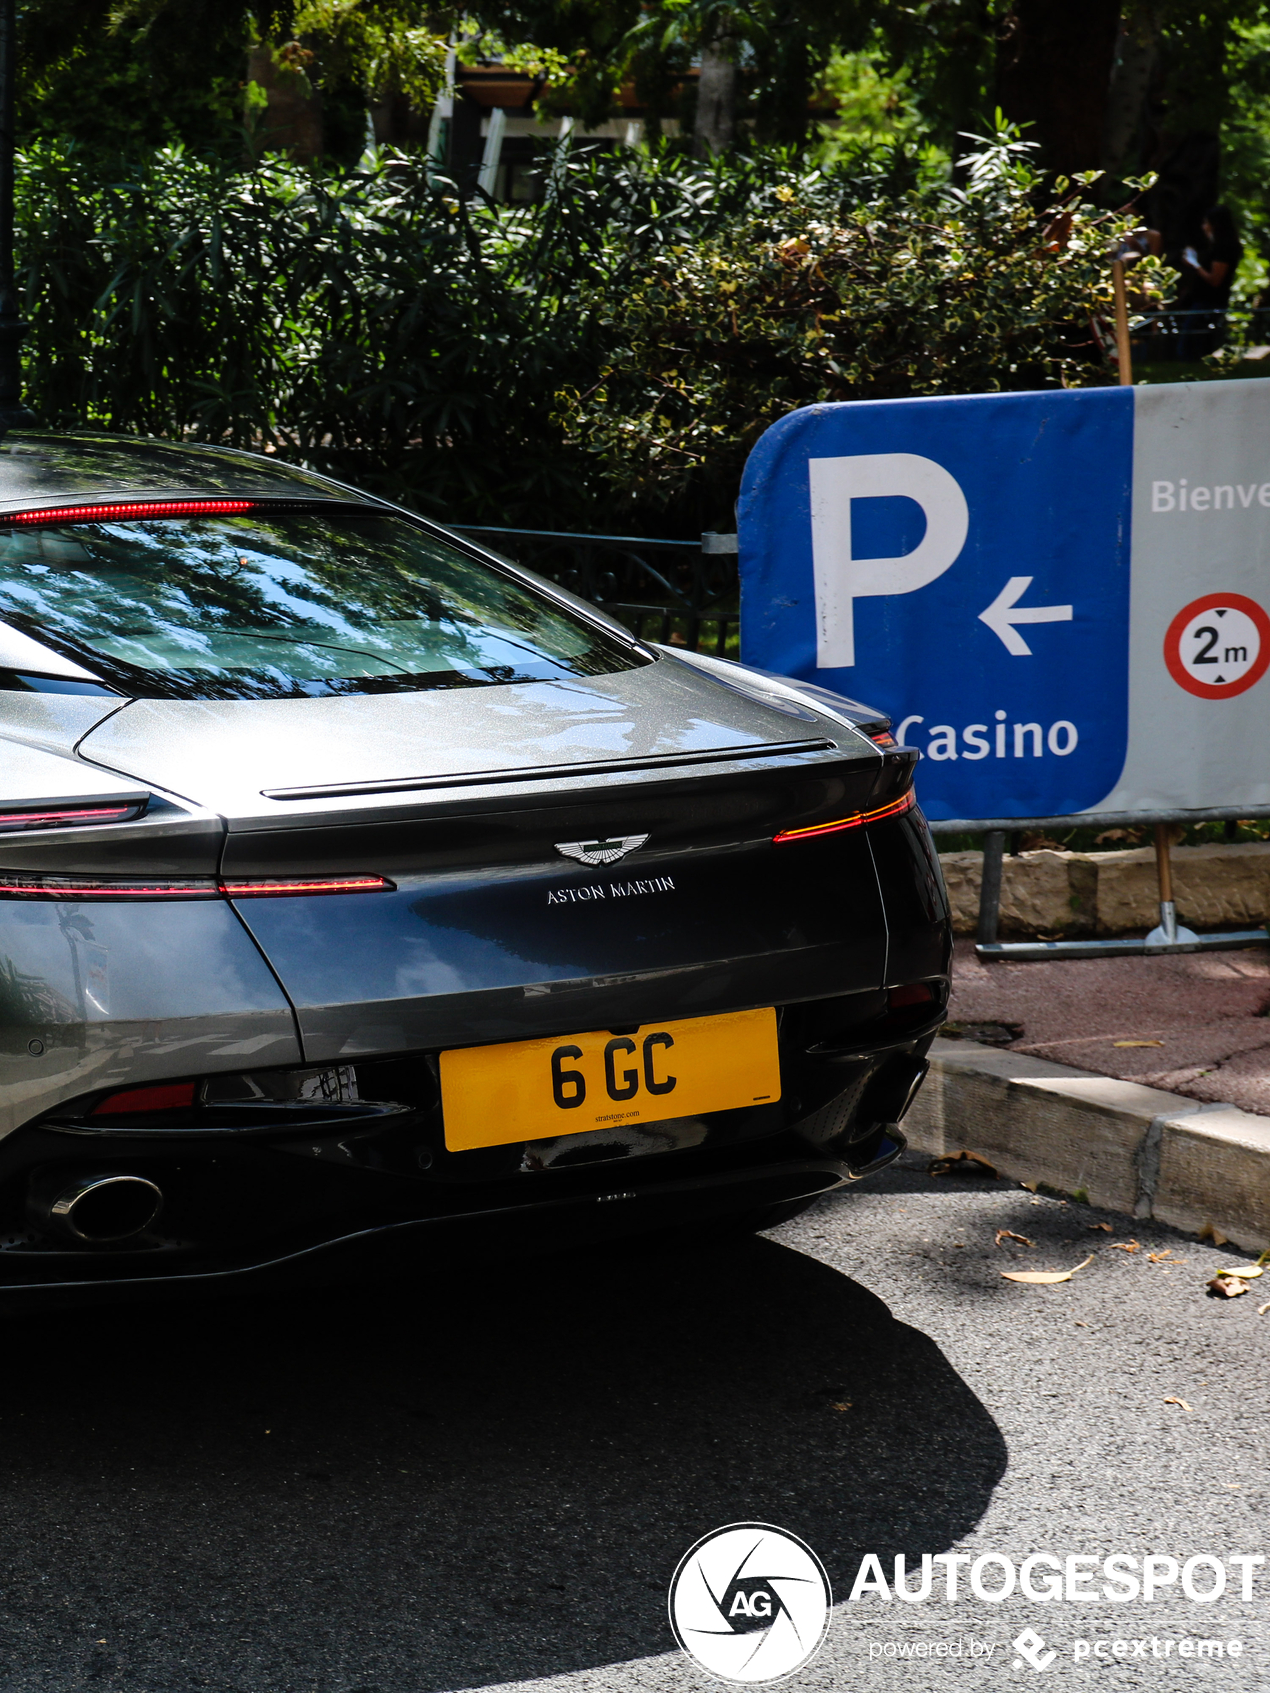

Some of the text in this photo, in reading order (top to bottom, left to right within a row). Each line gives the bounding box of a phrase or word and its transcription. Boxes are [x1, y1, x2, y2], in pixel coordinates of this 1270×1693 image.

[808, 453, 969, 669] P
[895, 709, 1079, 762] Casino
[547, 877, 675, 904] ASTON MARTIN
[551, 1032, 677, 1109] 6 GC
[595, 1110, 640, 1122] stratstone.com
